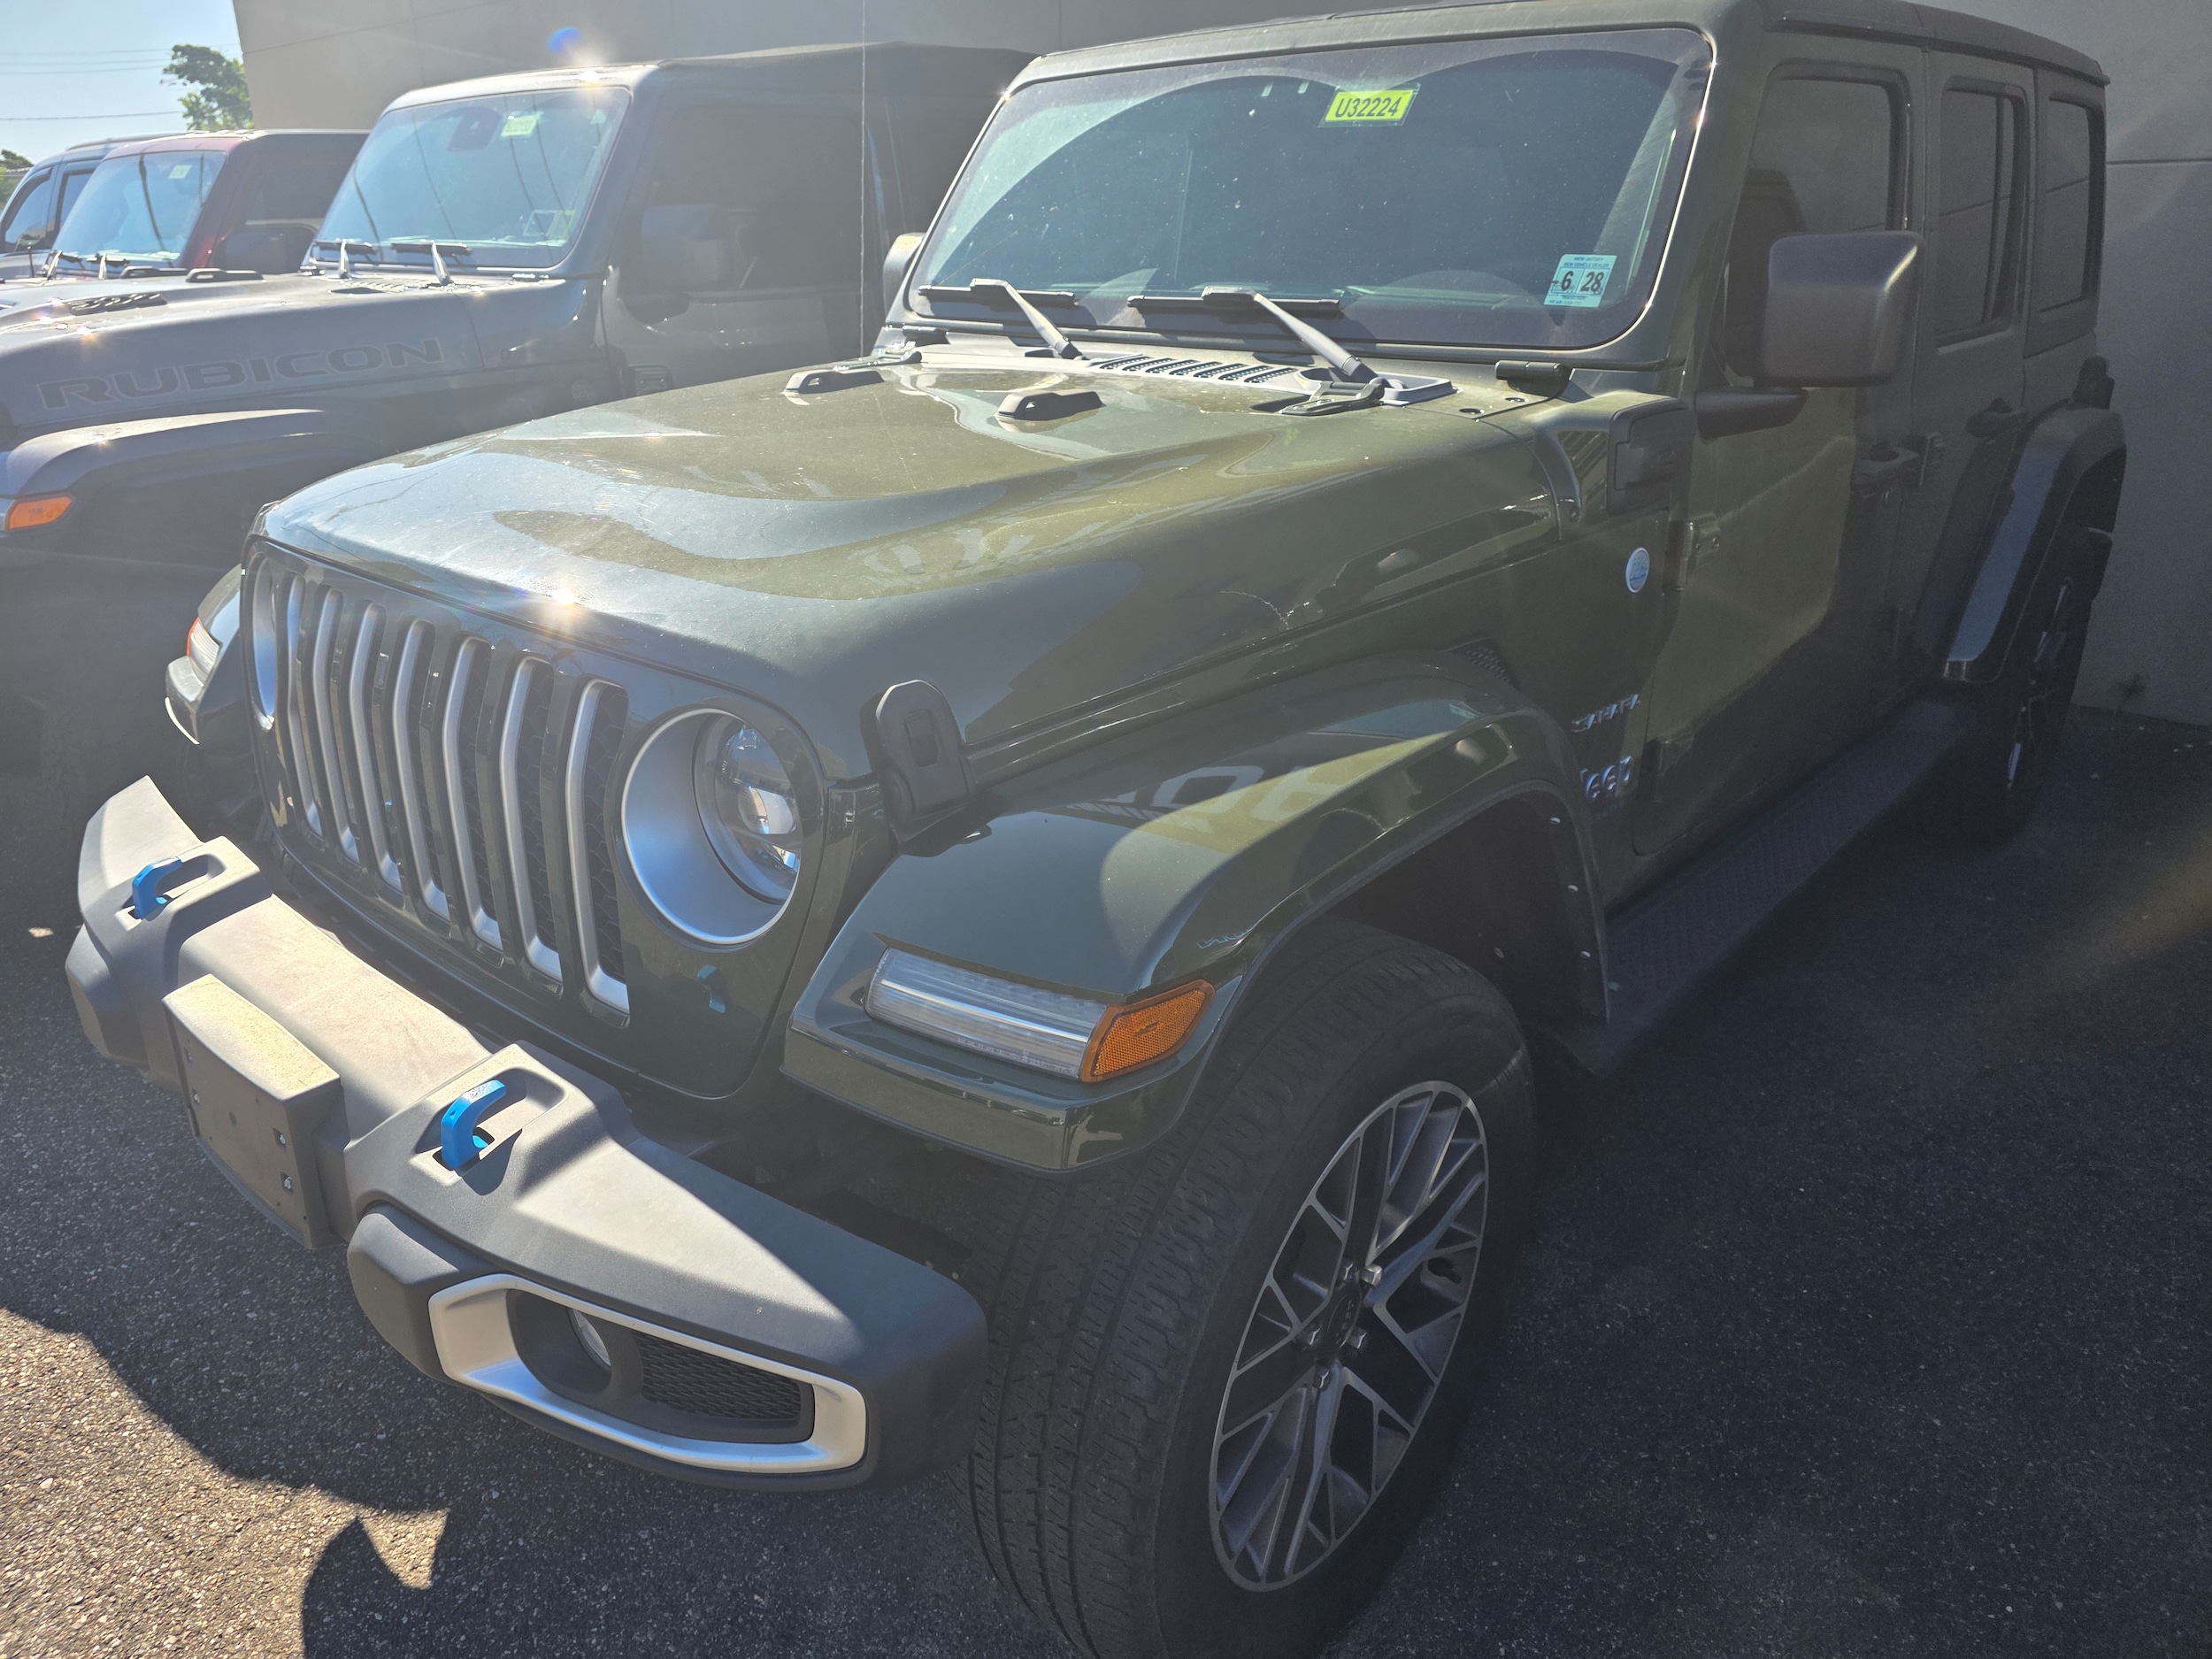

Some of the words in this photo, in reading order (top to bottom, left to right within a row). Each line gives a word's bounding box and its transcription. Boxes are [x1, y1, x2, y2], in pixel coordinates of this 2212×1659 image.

[1335, 97, 1402, 118] U32224
[1561, 270, 1574, 291] 6
[1579, 271, 1605, 292] 28
[36, 337, 445, 411] RUBICON
[1578, 755, 1633, 800] Jeep
